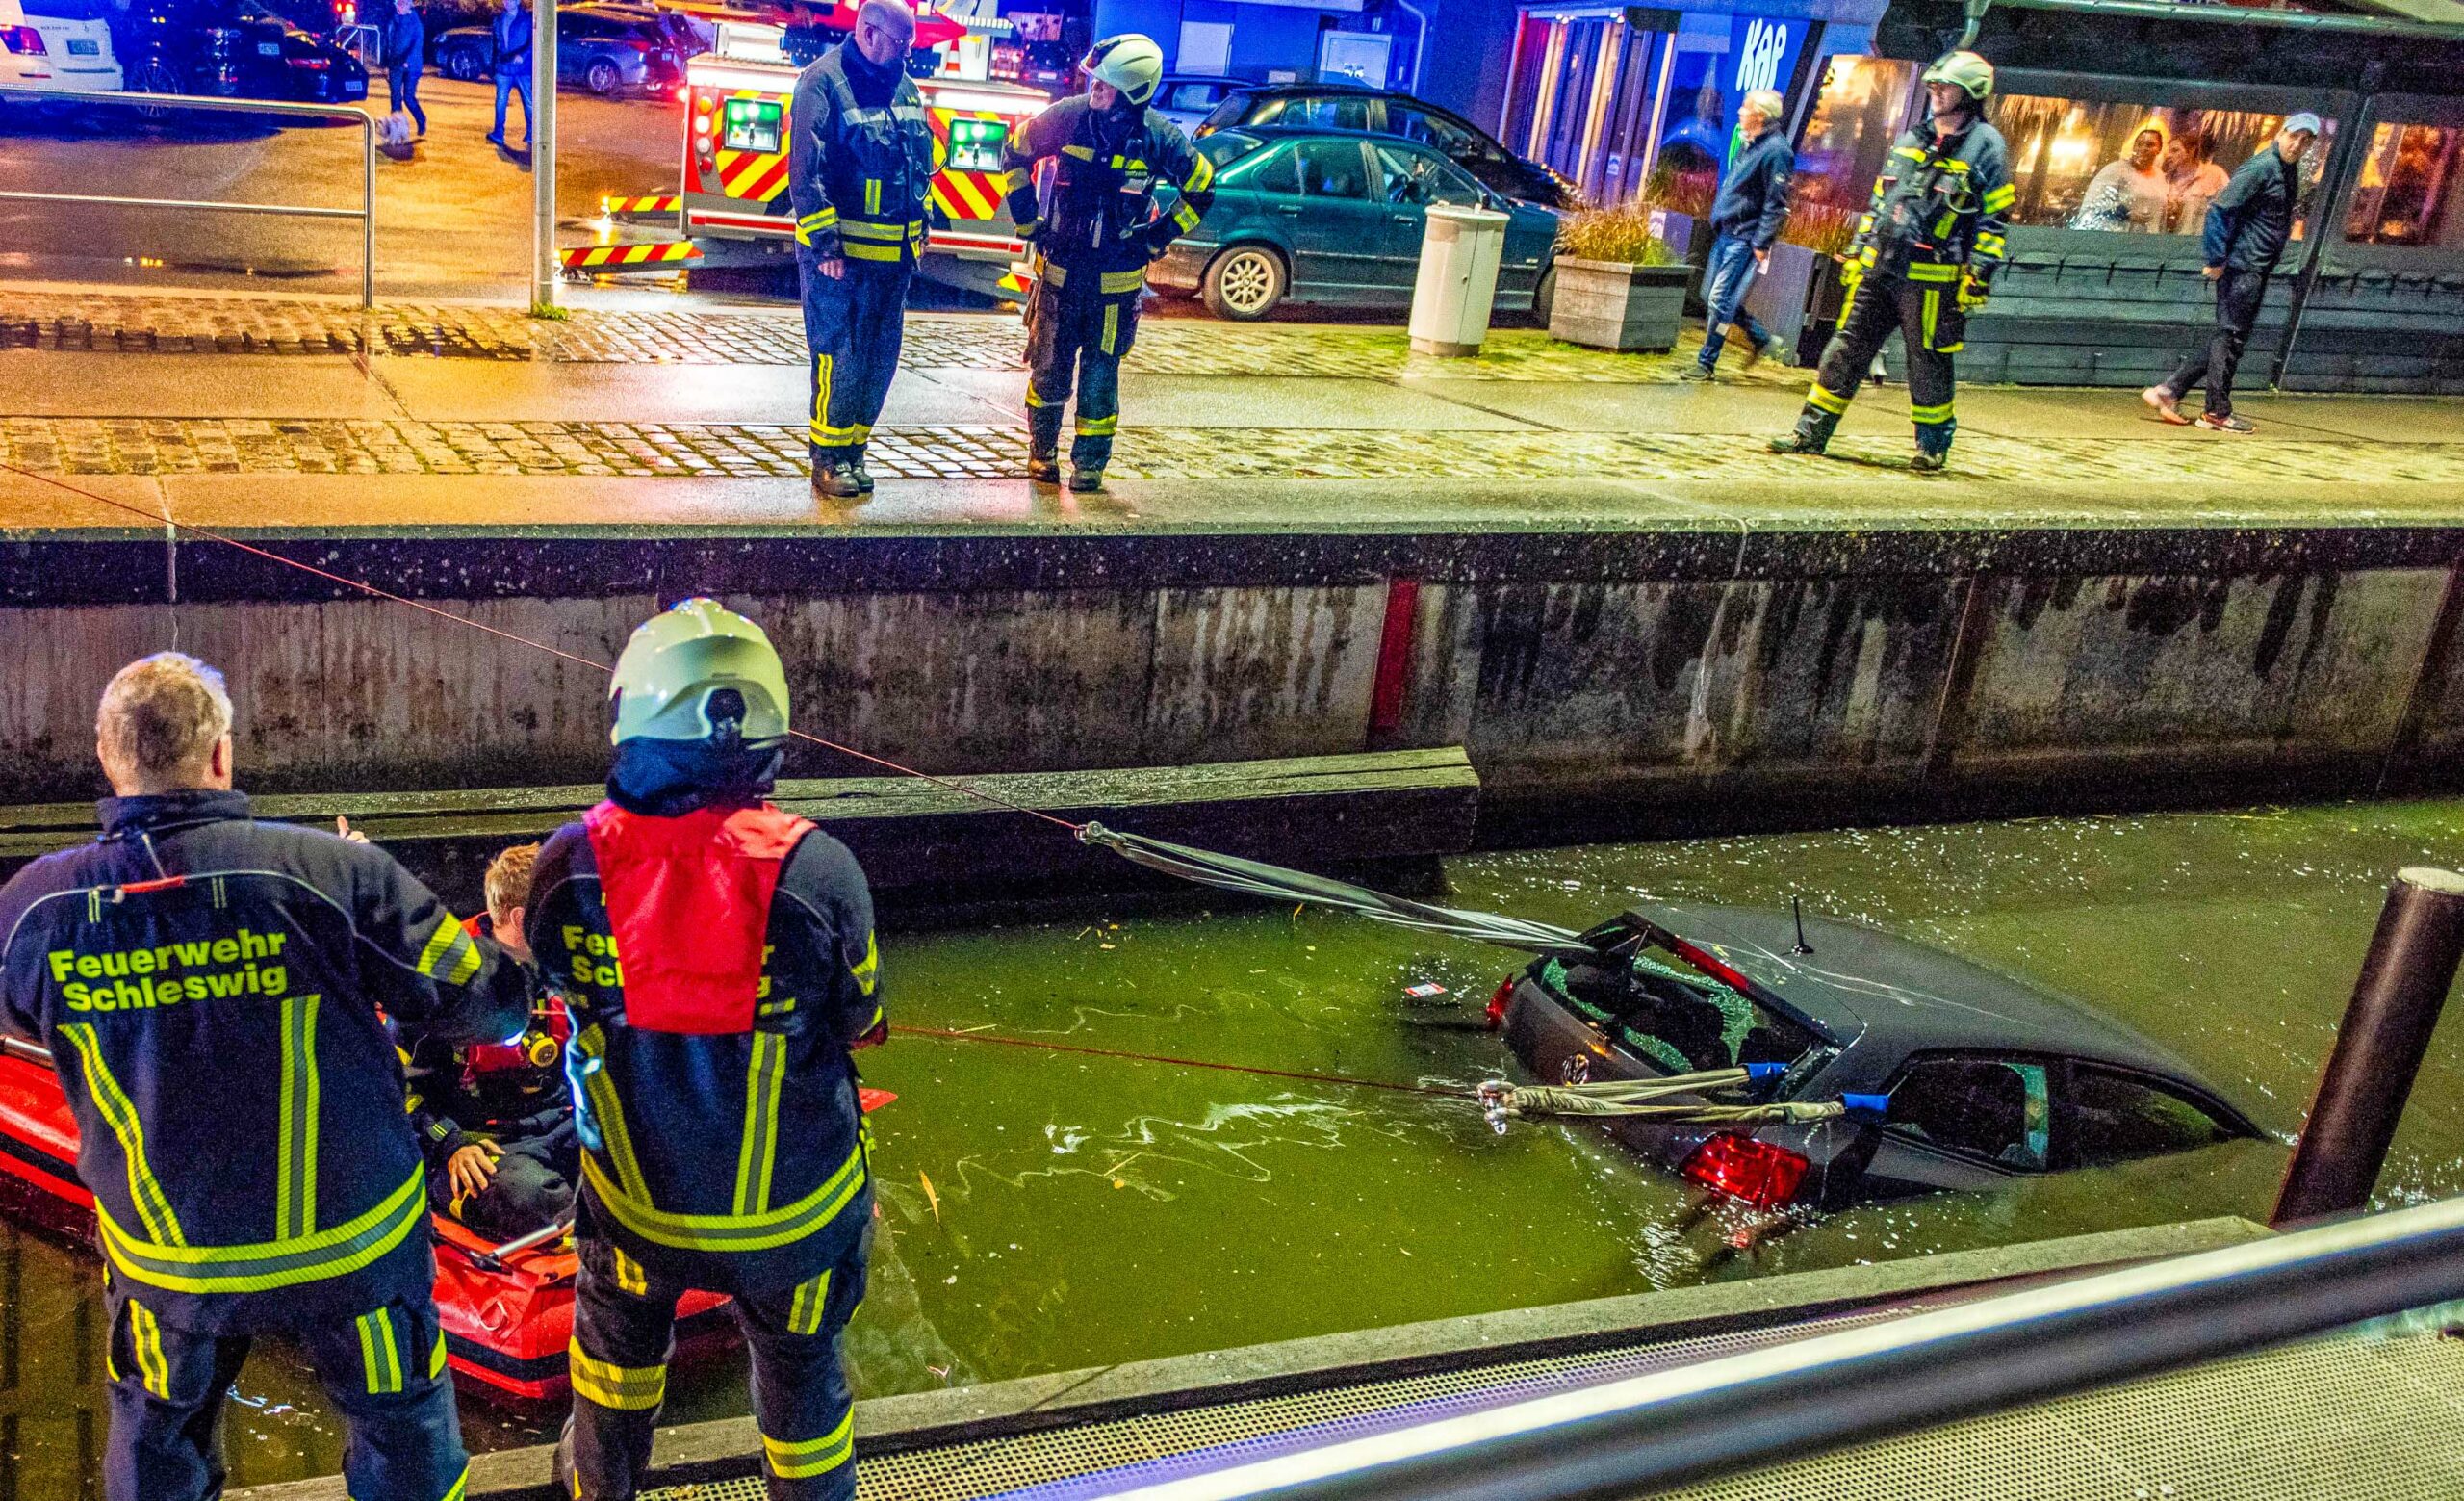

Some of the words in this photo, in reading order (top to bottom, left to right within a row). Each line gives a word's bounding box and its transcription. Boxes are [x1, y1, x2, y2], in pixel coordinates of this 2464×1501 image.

[1735, 17, 1787, 91] KAP
[49, 929, 287, 982] Feuerwehr
[63, 964, 288, 1012] Schleswig
